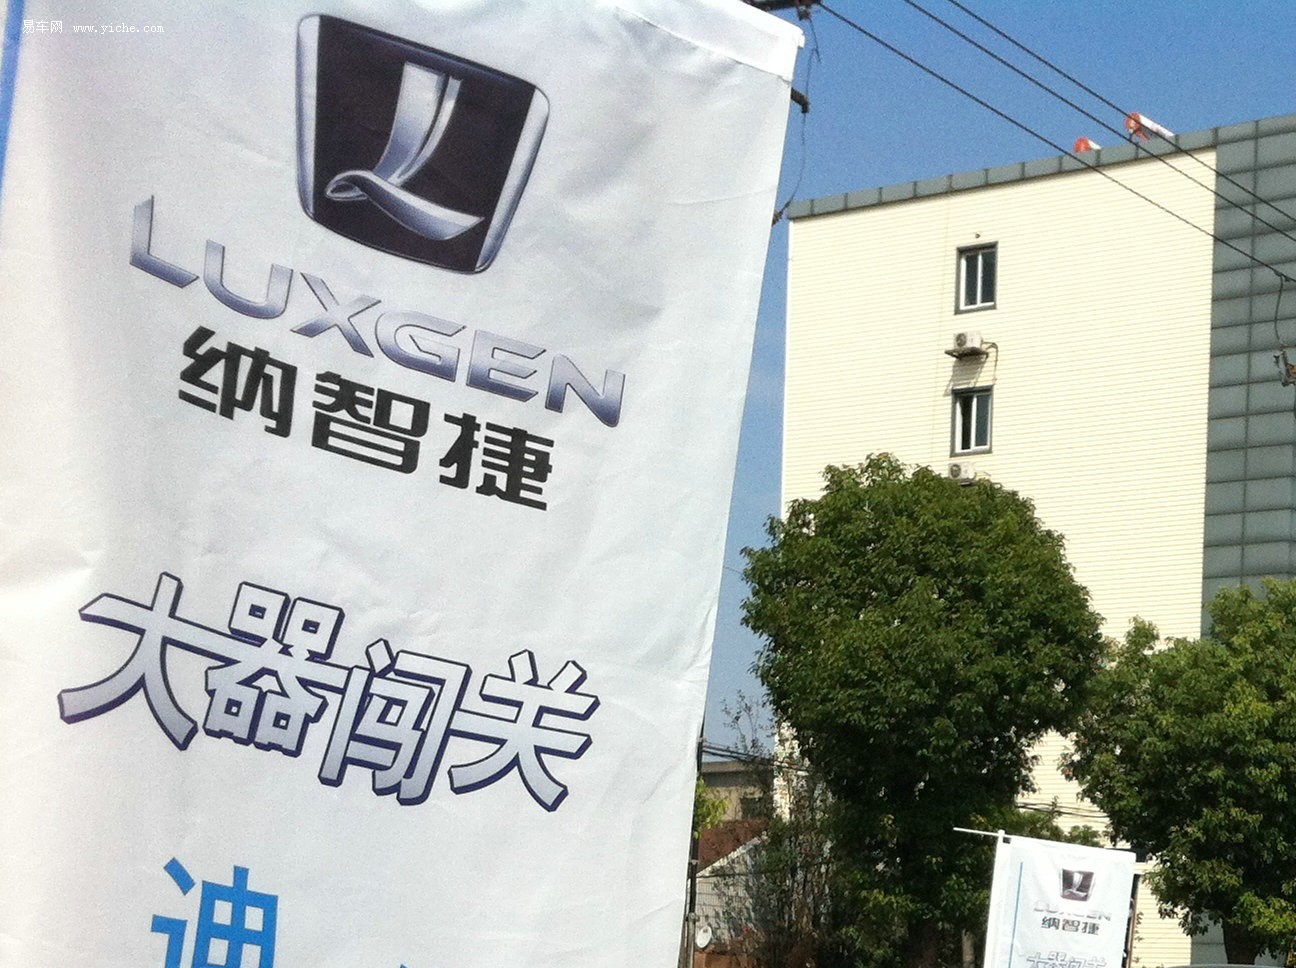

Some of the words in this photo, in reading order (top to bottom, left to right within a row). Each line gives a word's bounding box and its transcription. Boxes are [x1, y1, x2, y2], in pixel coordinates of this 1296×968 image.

[131, 193, 626, 428] LUXGEN
[178, 325, 556, 512] 纳智捷
[58, 571, 601, 813] 大器闯关
[1041, 915, 1100, 936] 纳智捷
